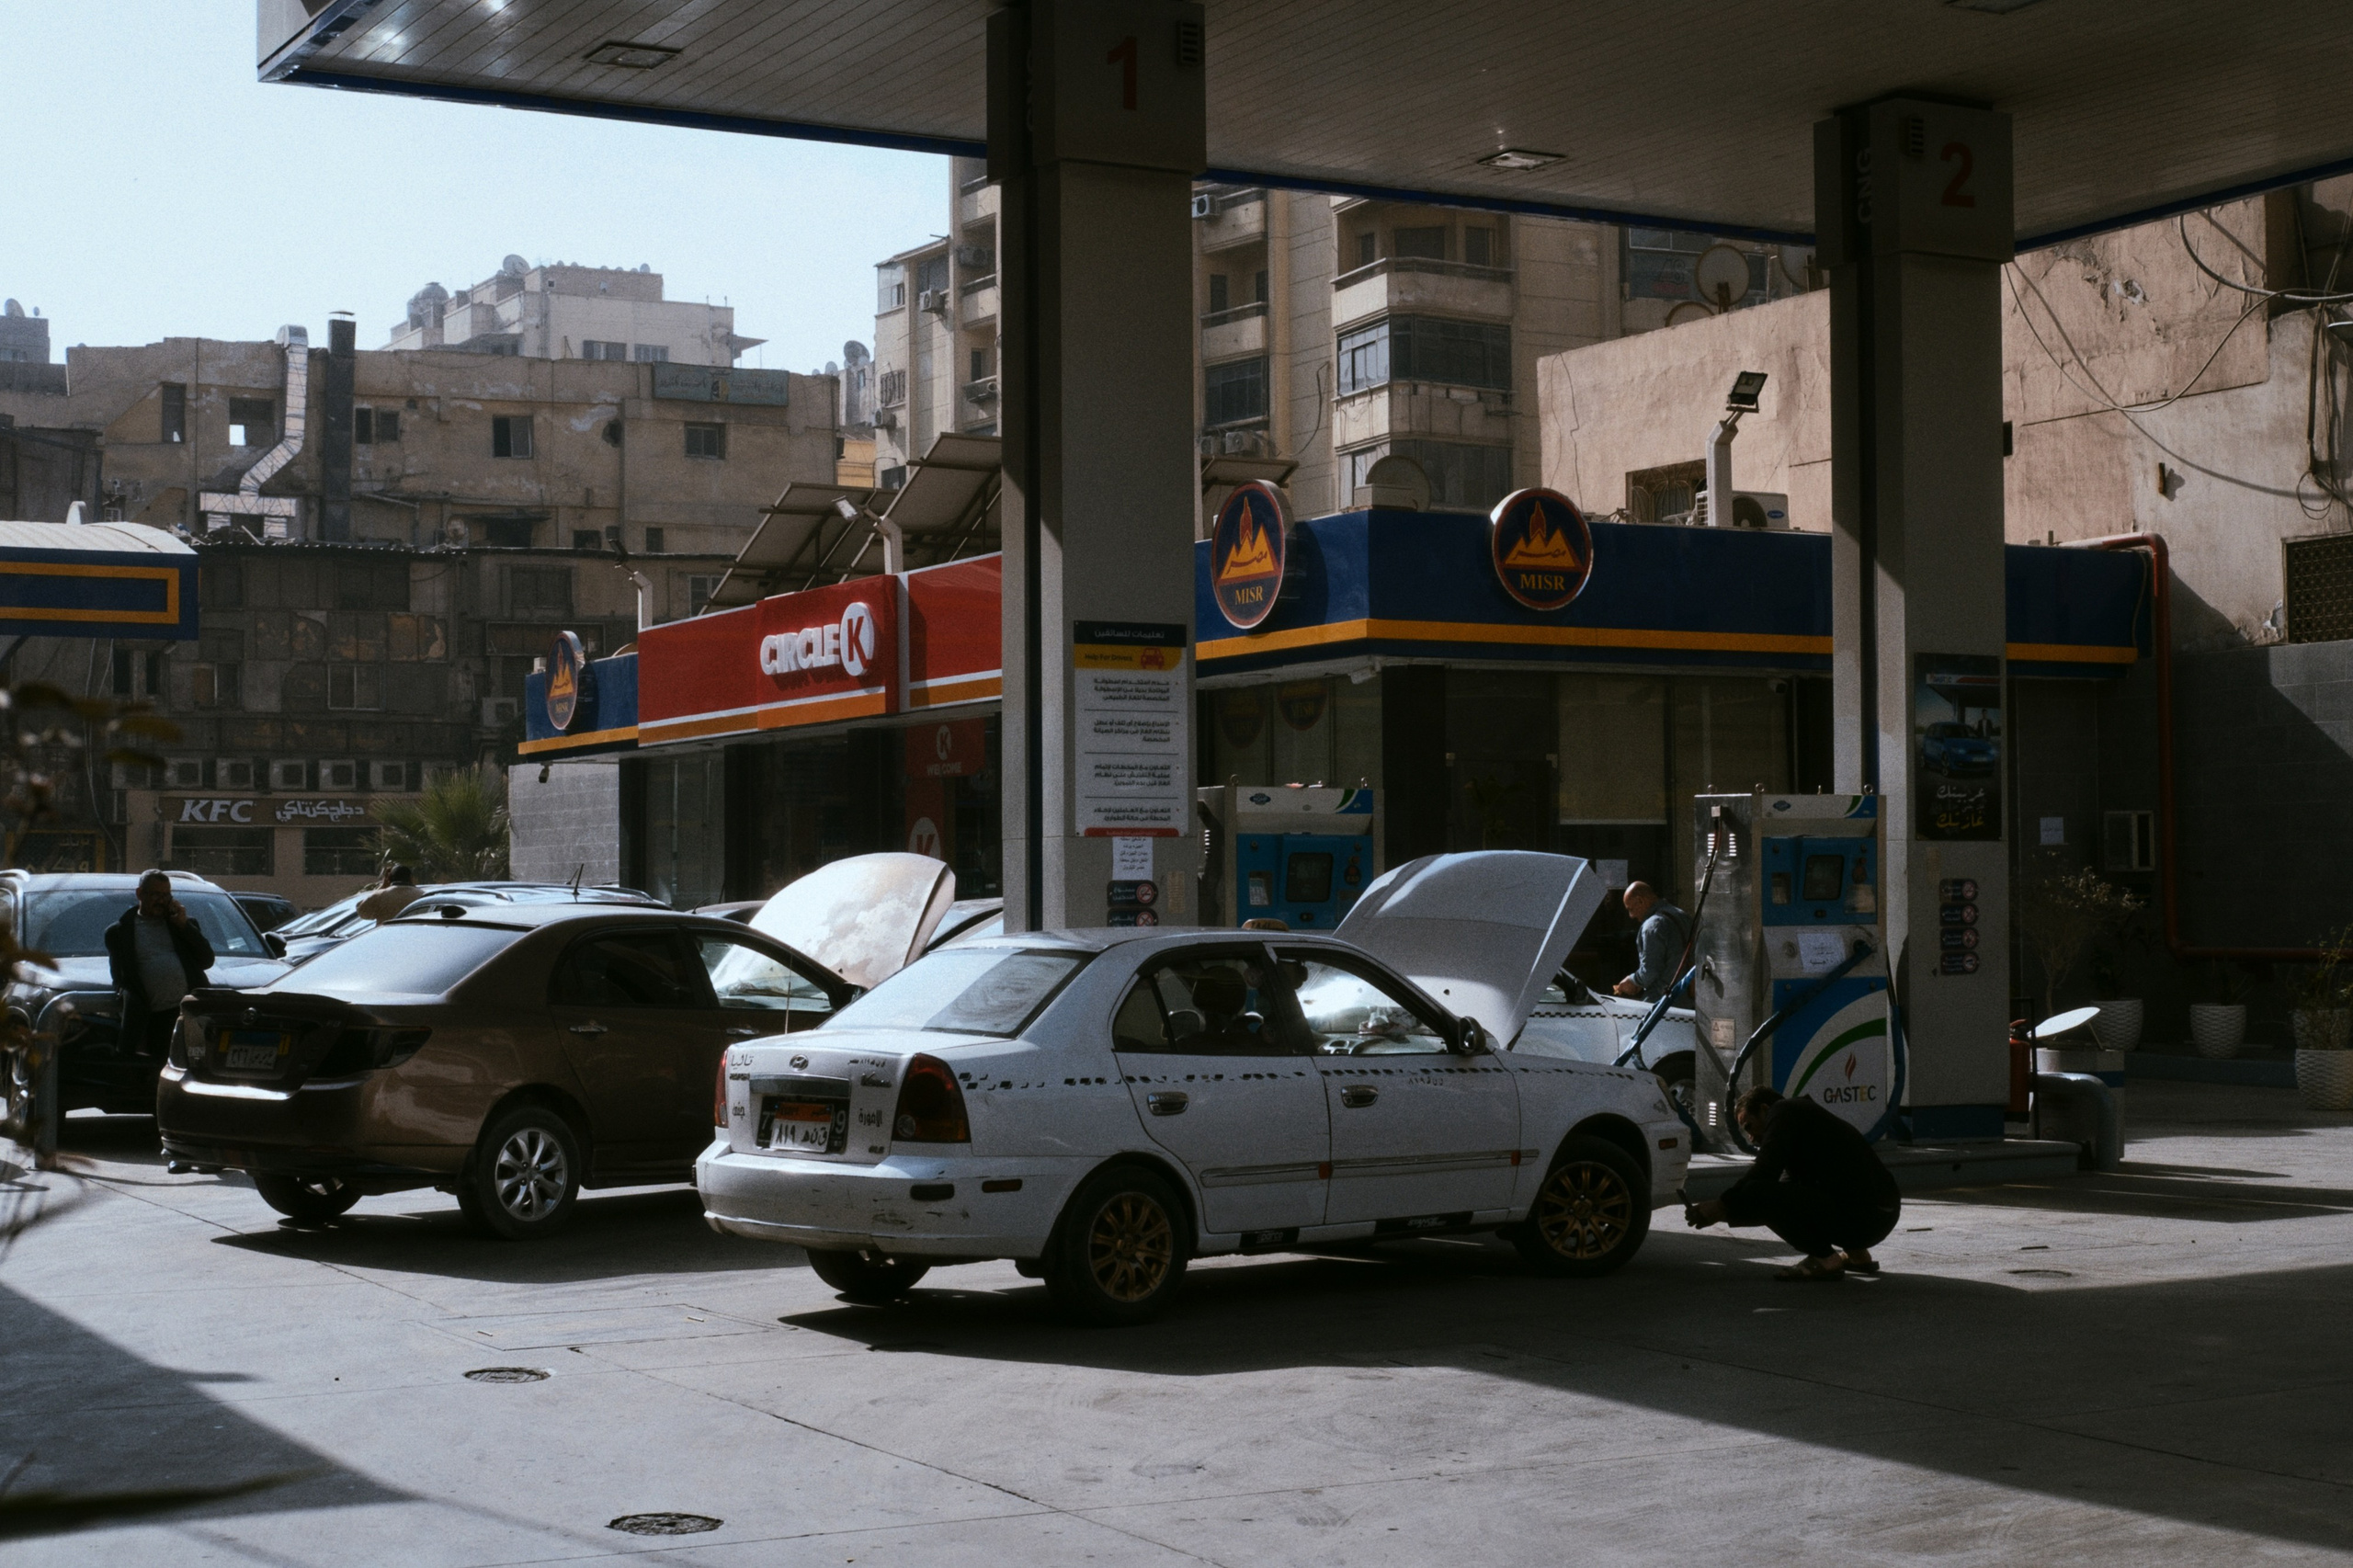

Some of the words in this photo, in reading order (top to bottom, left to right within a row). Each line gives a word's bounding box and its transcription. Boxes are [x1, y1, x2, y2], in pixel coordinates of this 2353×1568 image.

[1107, 37, 1137, 110] 1
[1856, 147, 1872, 223] CNG
[1940, 142, 1975, 208] 2
[1519, 574, 1565, 591] MISR
[1234, 585, 1263, 606] MISR
[1094, 629, 1131, 639] للسائقين
[1131, 630, 1165, 639] تعليمات
[759, 622, 840, 676] CIRCLE
[179, 799, 255, 823] KFC
[1823, 1085, 1877, 1104] GASTEC
